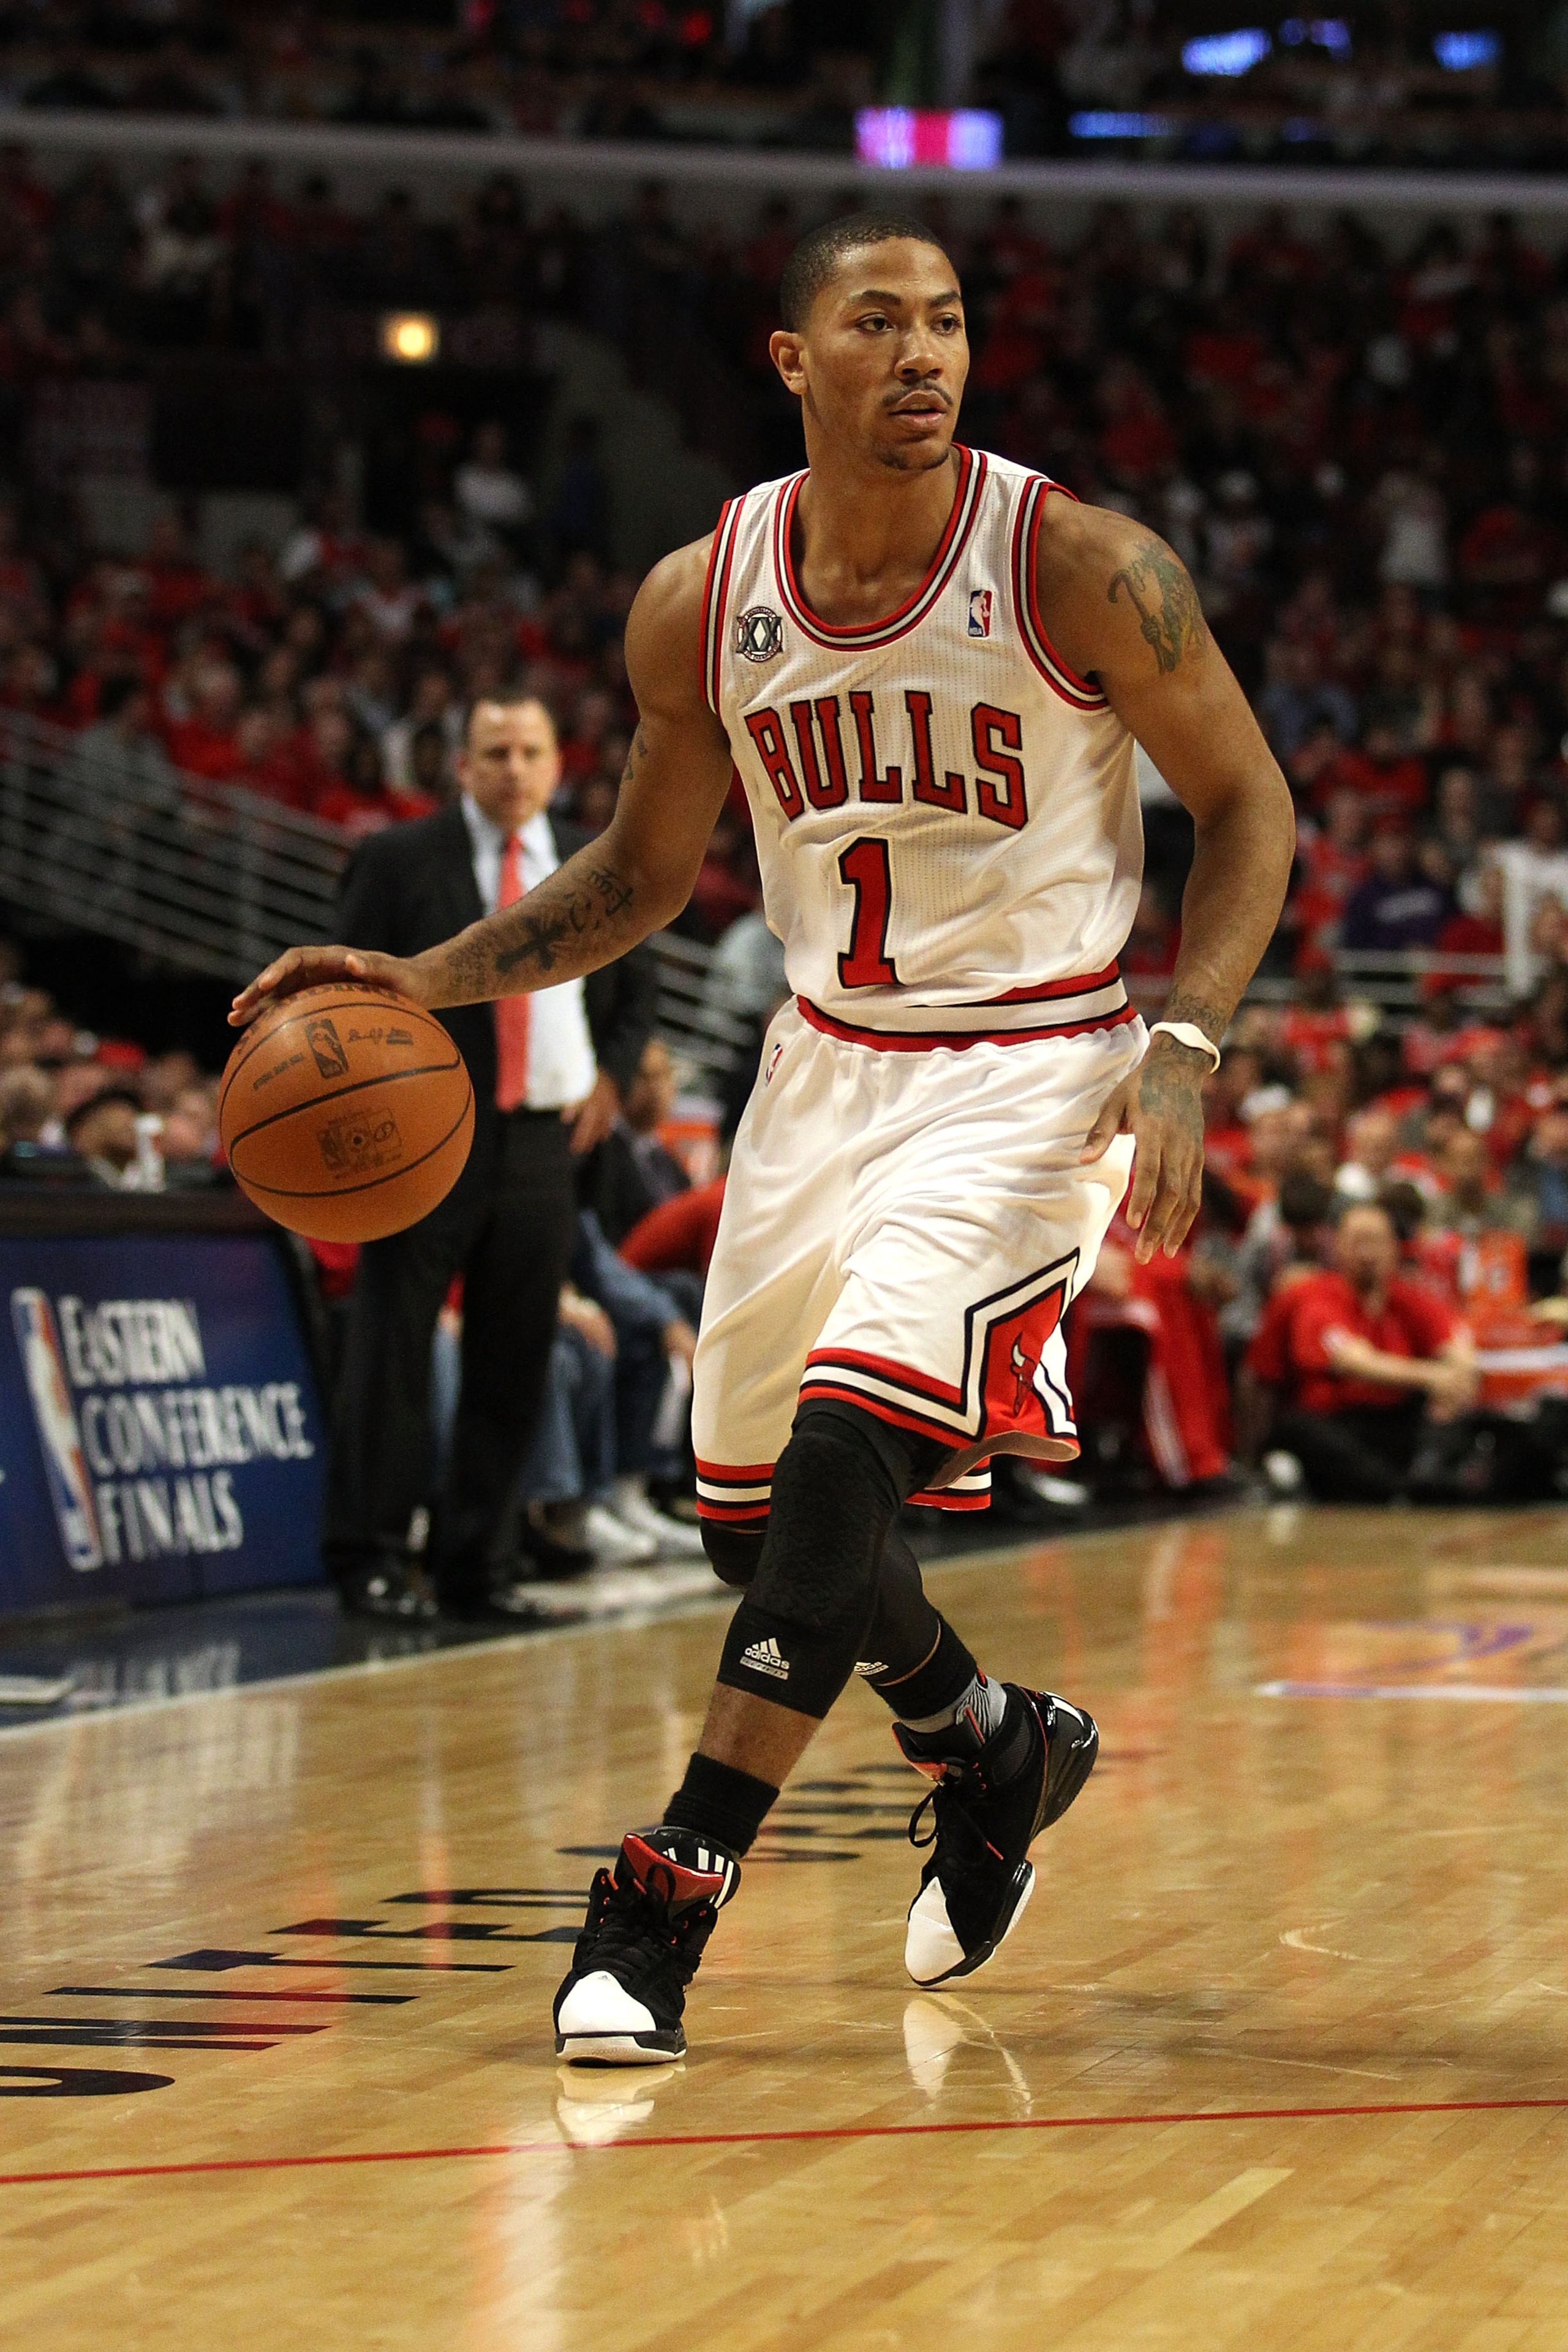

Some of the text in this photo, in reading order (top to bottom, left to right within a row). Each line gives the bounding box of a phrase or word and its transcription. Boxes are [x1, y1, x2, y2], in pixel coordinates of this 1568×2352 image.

[744, 690, 1028, 831] BULLS
[837, 837, 899, 989] 1
[59, 1295, 206, 1387] EASTERN
[81, 1382, 314, 1475] CONFERENCE
[96, 1470, 243, 1563] FINALS
[745, 1648, 790, 1670] adidas
